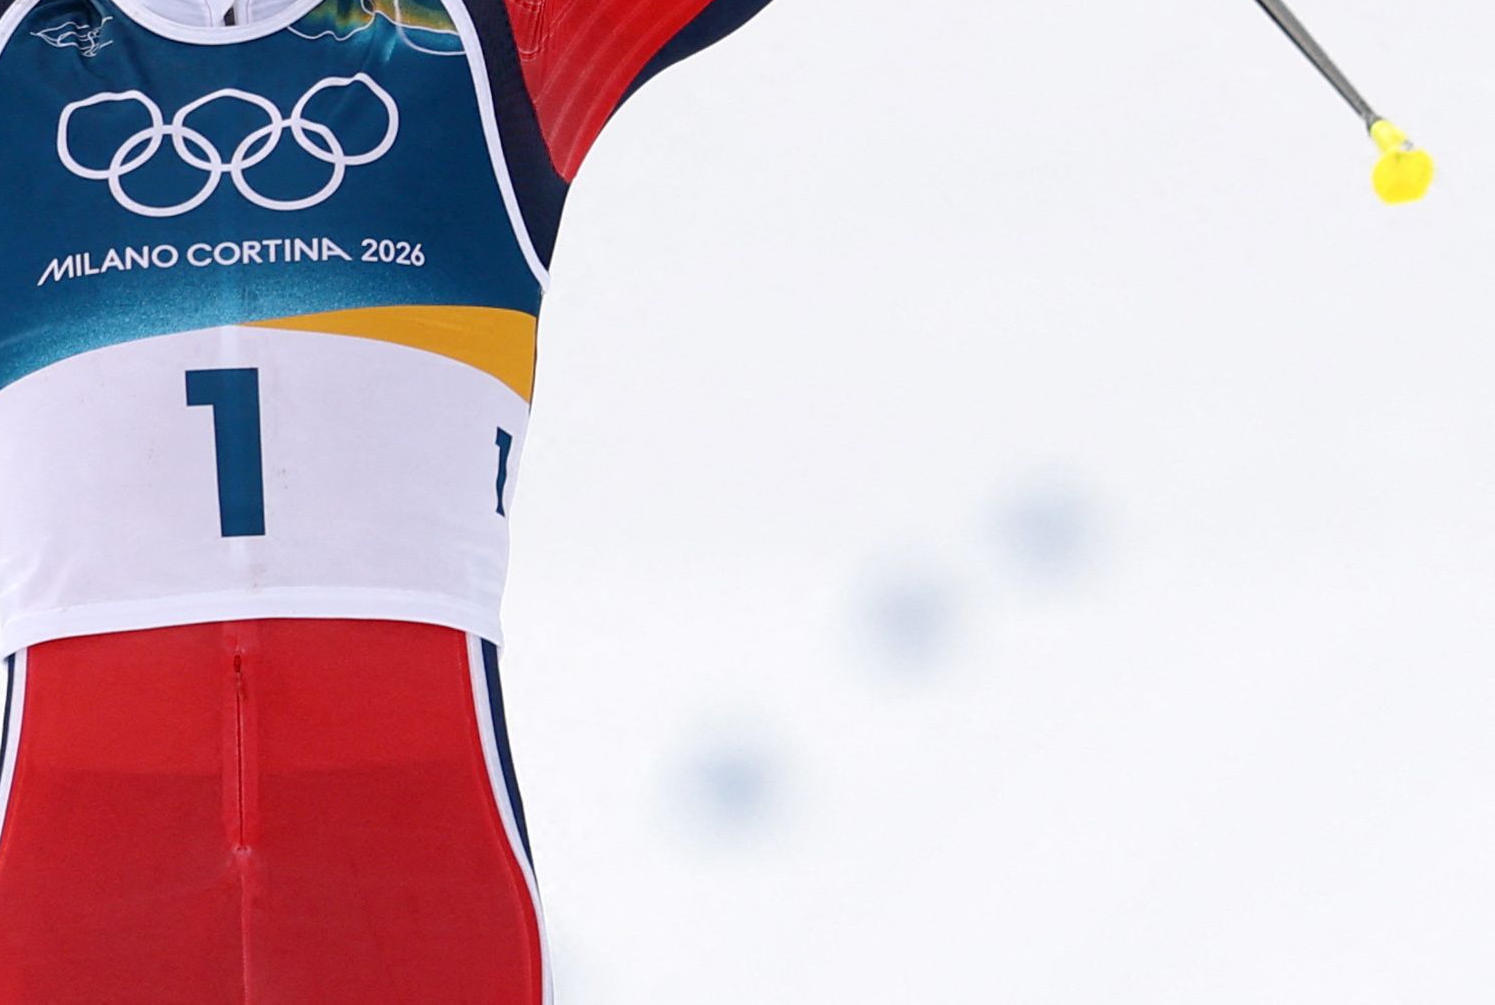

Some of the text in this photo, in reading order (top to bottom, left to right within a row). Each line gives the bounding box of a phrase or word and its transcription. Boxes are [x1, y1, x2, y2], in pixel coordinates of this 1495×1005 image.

[37, 238, 426, 286] MILANO CORTINA 2026
[185, 367, 266, 537] 1
[495, 426, 513, 517] 1
